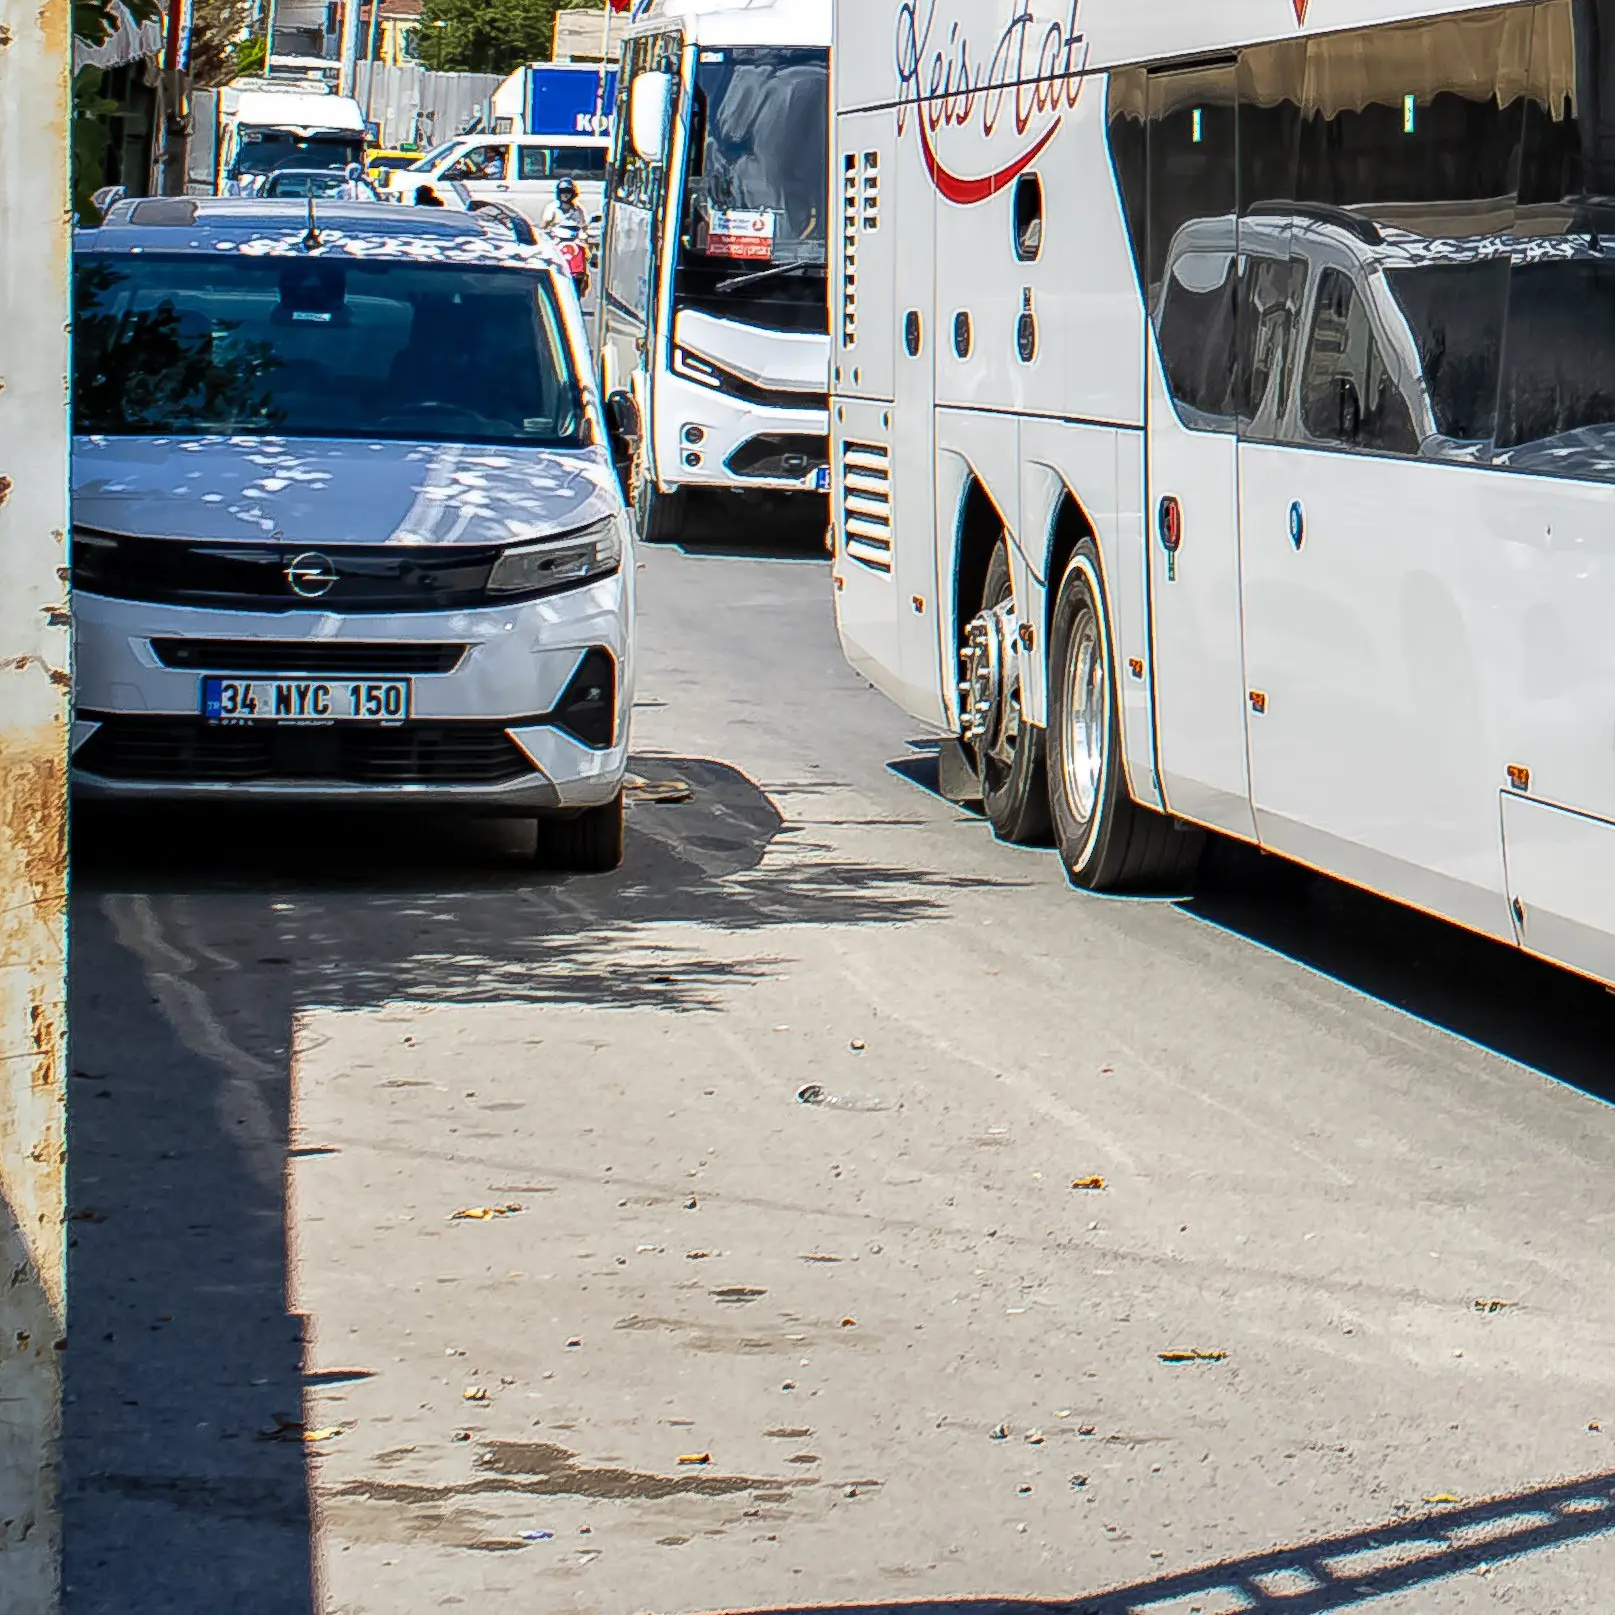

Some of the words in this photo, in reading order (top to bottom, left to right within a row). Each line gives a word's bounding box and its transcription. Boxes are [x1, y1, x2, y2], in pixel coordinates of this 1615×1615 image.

[576, 113, 615, 132] KO
[222, 682, 258, 716] 34
[275, 683, 331, 716] NYC
[350, 684, 403, 717] 150
